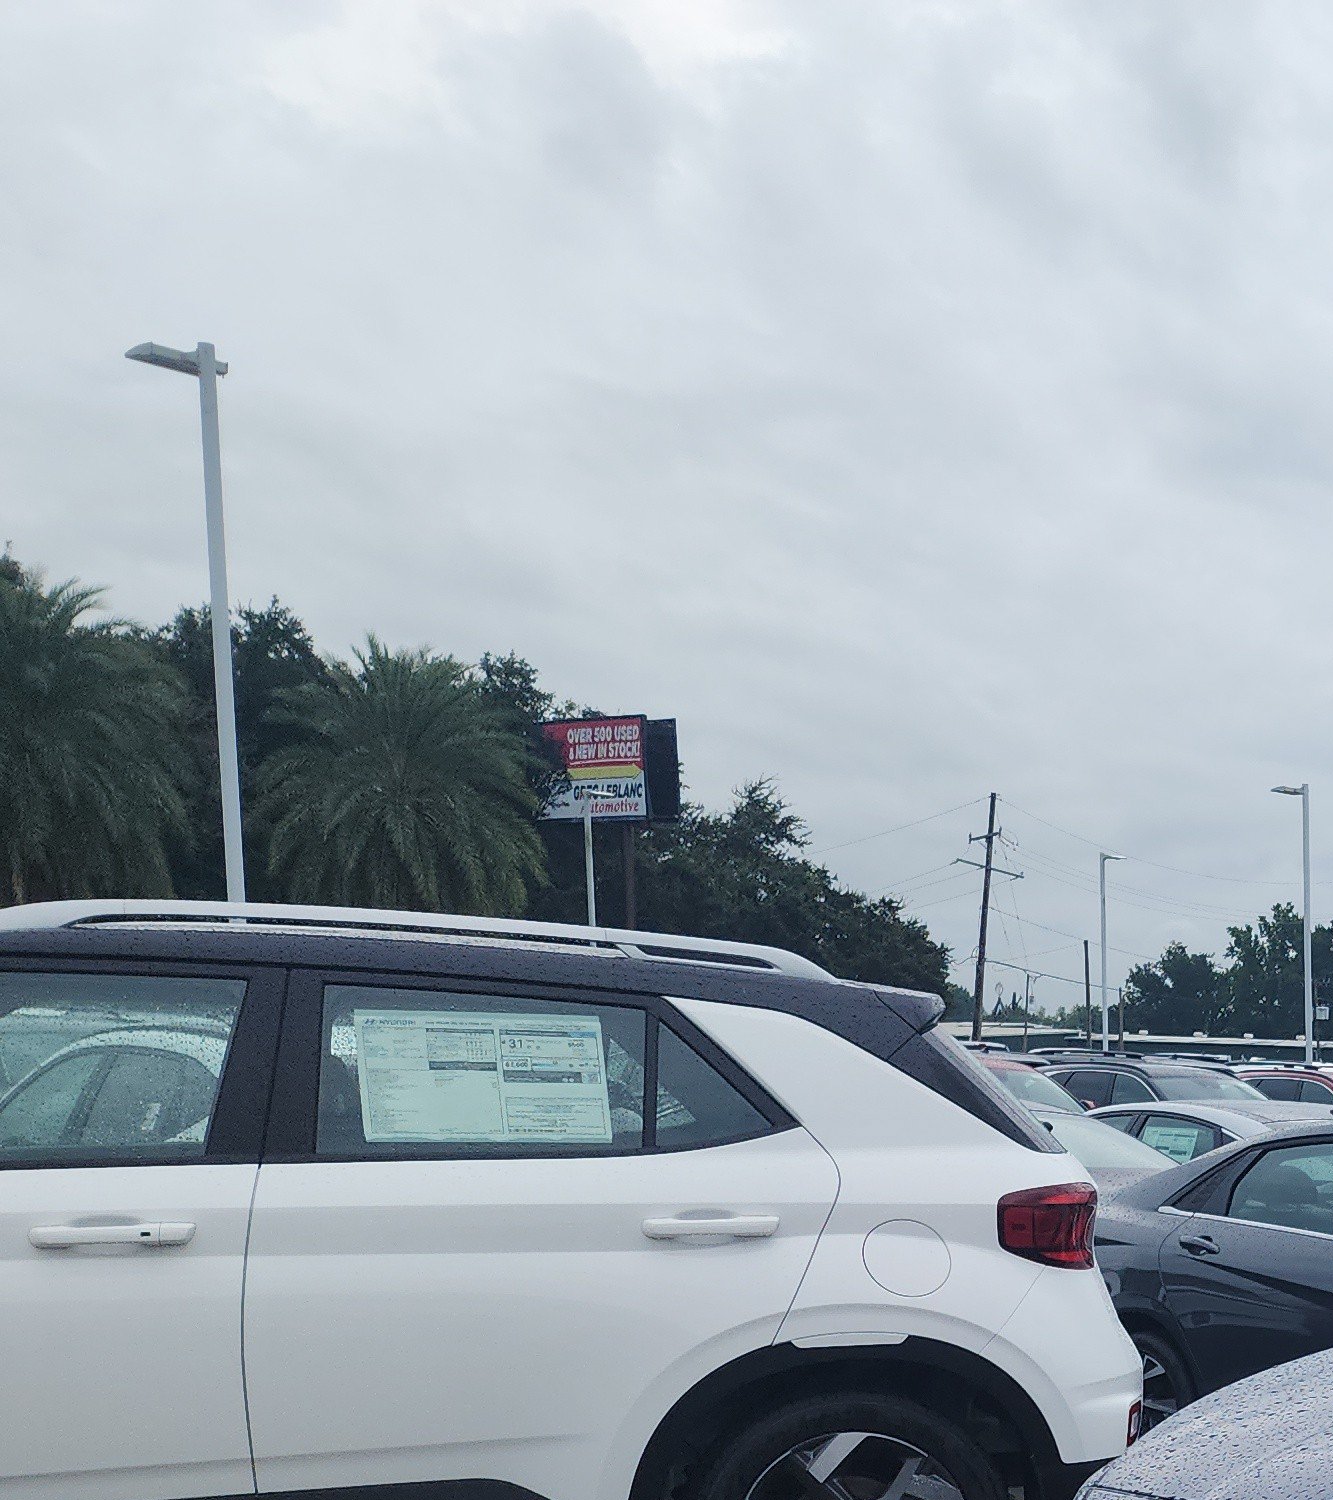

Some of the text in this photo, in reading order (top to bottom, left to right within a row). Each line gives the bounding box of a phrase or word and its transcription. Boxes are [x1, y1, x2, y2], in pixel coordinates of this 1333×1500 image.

[567, 724, 640, 743] OVER 500 USED
[575, 743, 597, 760] NEW
[597, 741, 608, 758] IN
[608, 741, 641, 758] STOCK!
[581, 799, 639, 813] tomotive
[379, 1019, 416, 1027] HYUNDAI
[508, 1038, 523, 1050] 31
